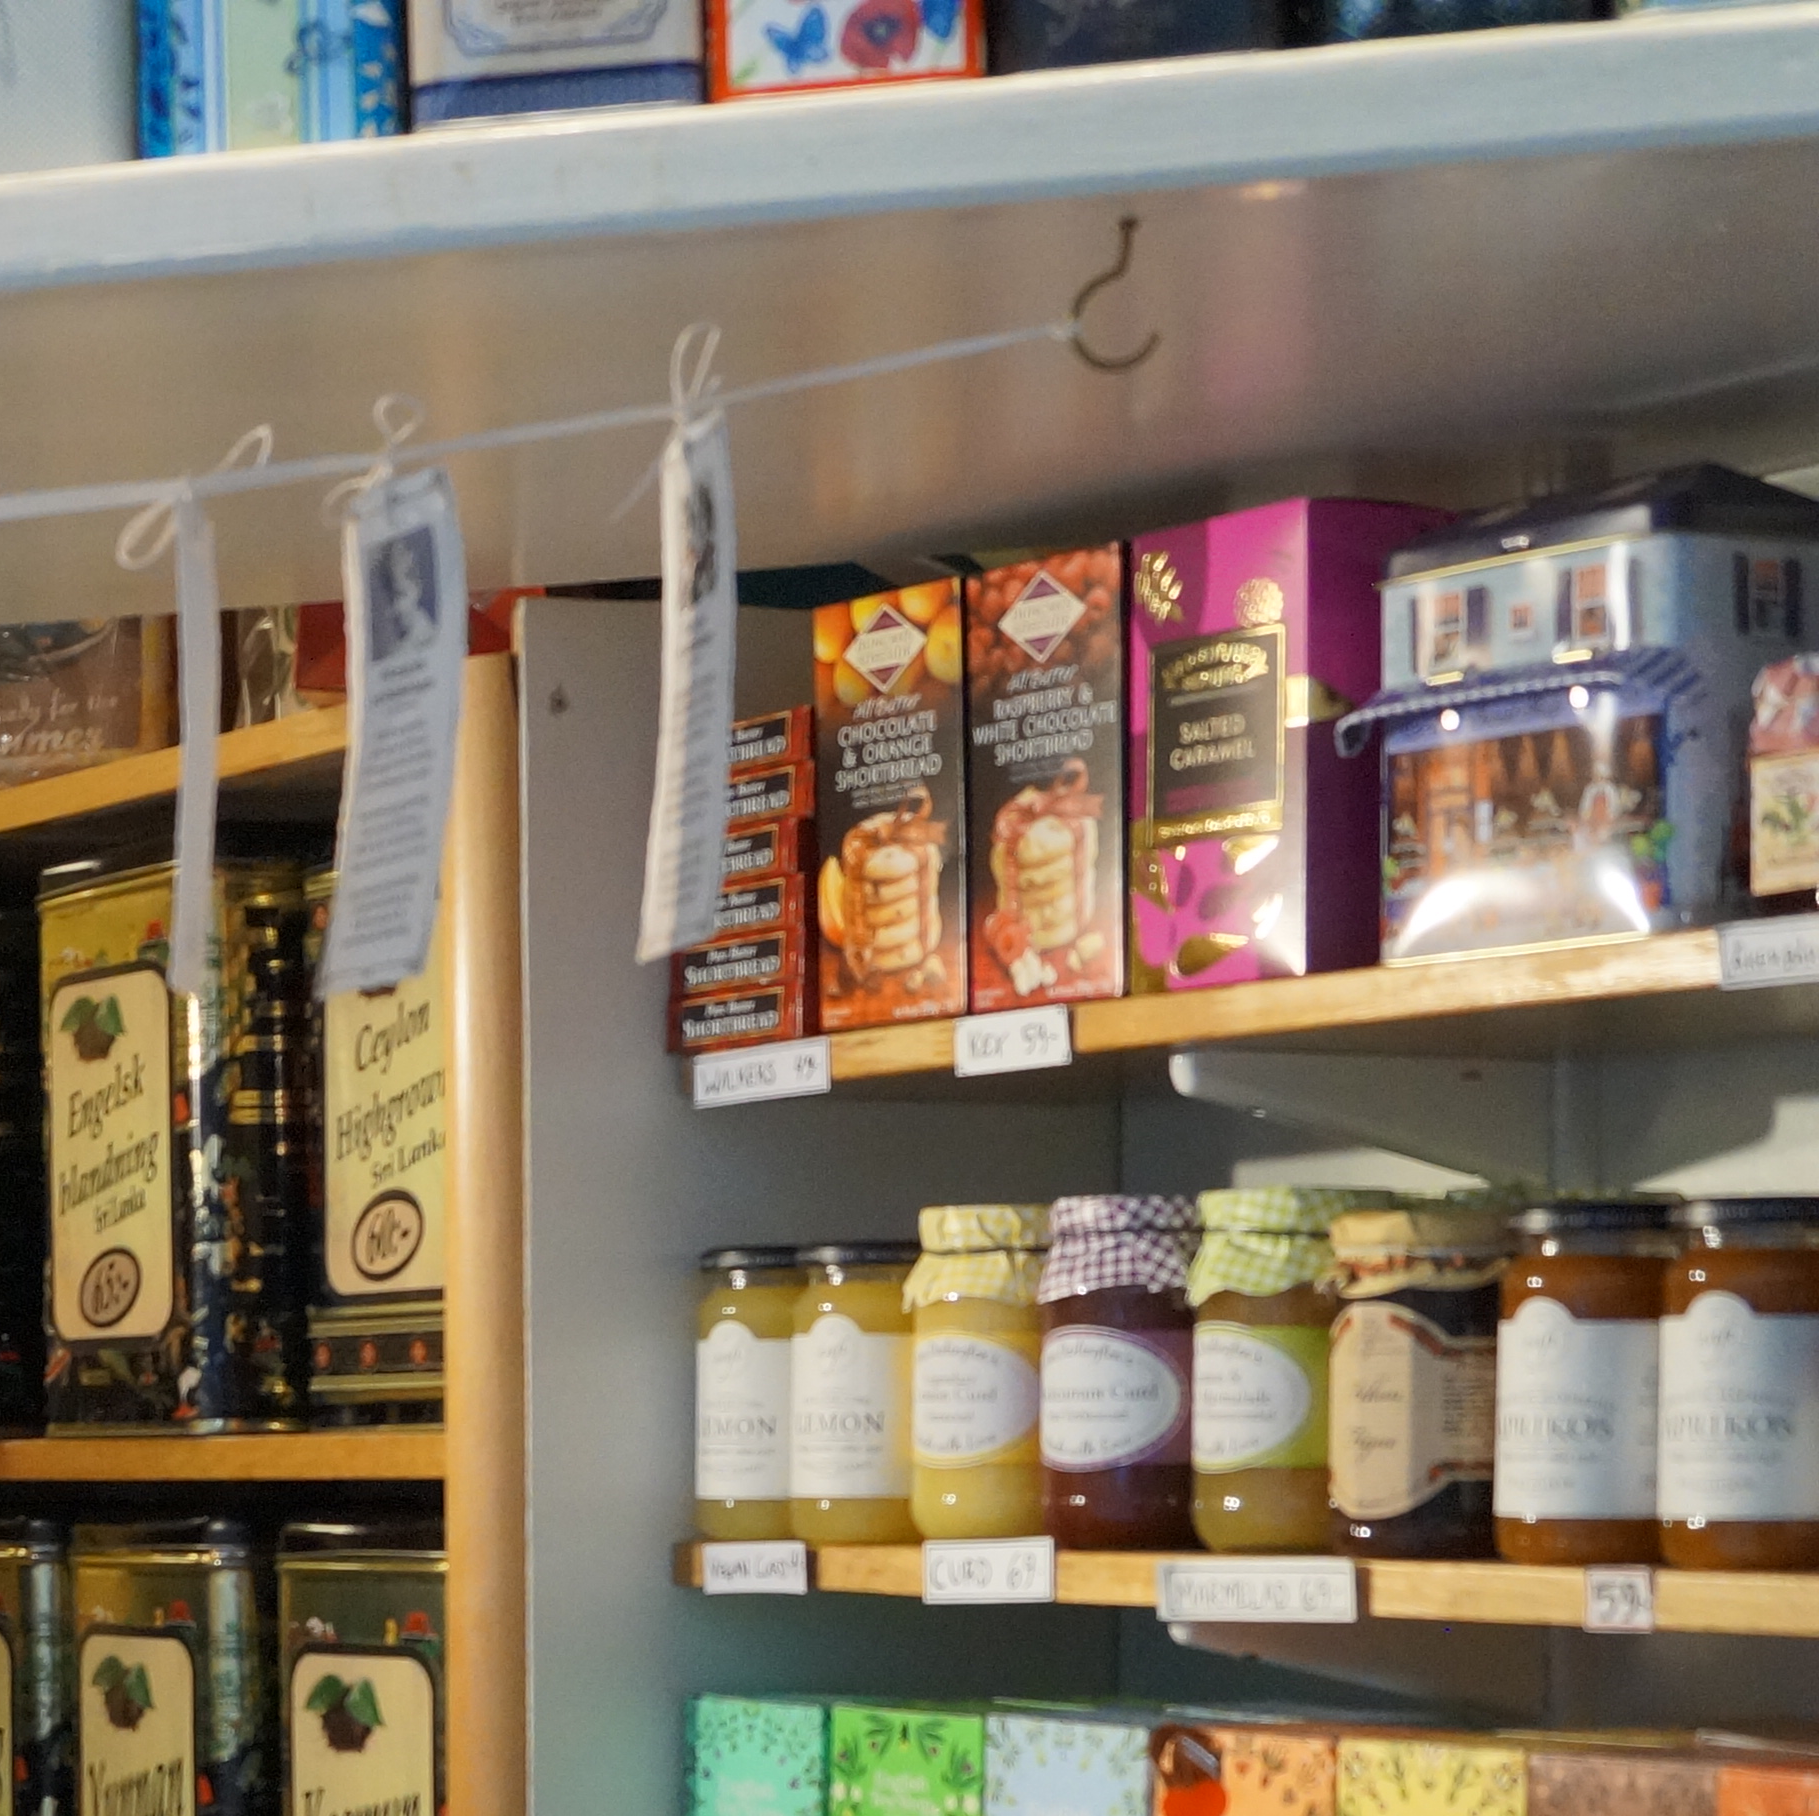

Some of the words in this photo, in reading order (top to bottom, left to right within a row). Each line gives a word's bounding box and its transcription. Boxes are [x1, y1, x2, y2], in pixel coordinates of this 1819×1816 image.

[837, 712, 937, 747] CHOCOLATE
[972, 724, 1019, 745] WHITE
[1022, 702, 1117, 738] CHOCOLATE
[1179, 714, 1246, 742] SALTED
[862, 735, 933, 766] ORANGE
[995, 732, 1093, 766] SHORTBREAD
[1169, 740, 1257, 770] CARAMEL
[835, 754, 943, 792] SHORTBREAD
[68, 1055, 145, 1140] Engelsk
